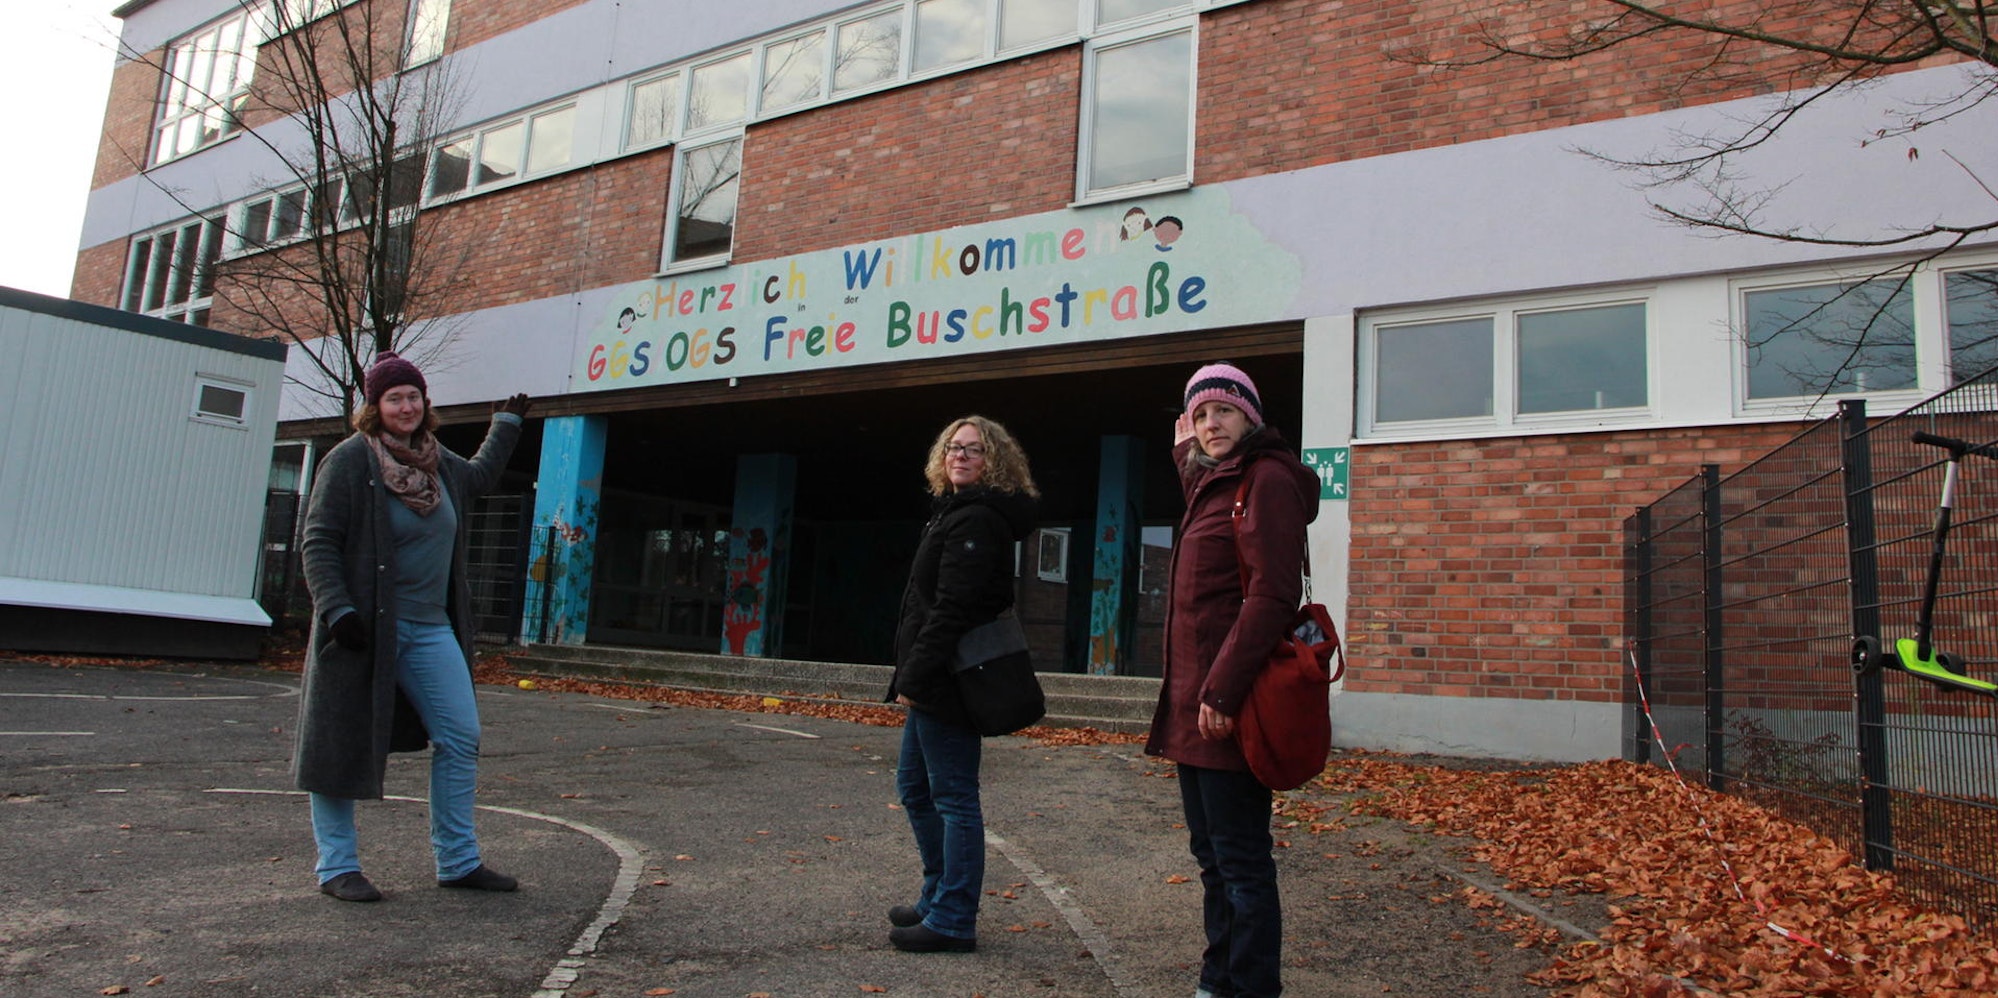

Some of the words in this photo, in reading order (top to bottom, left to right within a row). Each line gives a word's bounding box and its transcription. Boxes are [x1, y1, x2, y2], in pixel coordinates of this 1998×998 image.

[653, 262, 806, 320] Herzlich
[844, 223, 1118, 290] Willkommen
[764, 313, 855, 361] Freie
[887, 262, 1207, 348] Buschstraße
[797, 303, 806, 312] in
[844, 295, 859, 305] der
